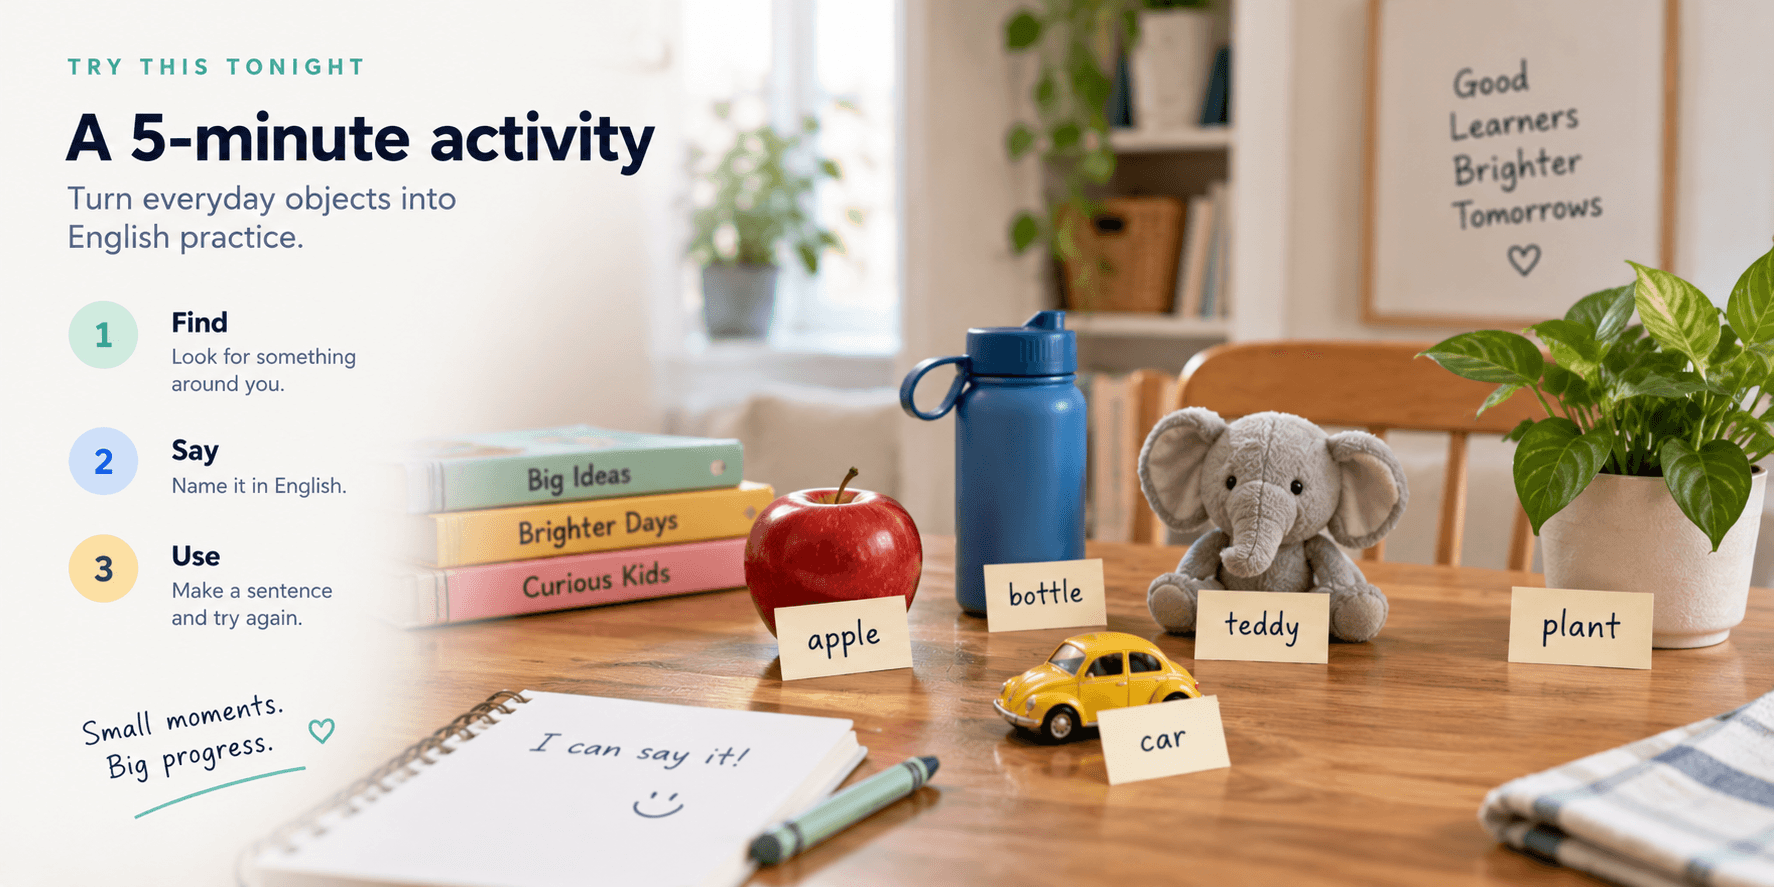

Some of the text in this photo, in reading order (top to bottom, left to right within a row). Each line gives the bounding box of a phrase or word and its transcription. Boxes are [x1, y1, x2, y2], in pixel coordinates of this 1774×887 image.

[1453, 59, 1529, 99] Good
[1450, 108, 1578, 141] Learners
[1454, 149, 1581, 193] Brighter
[1452, 197, 1602, 230] Tomorrows
[528, 464, 630, 497] Big Ideas
[519, 511, 677, 548] Brighter Days
[523, 562, 670, 598] Curious Kids
[1010, 578, 1082, 606] bottle
[809, 619, 880, 659] apple
[1225, 610, 1298, 647] teddy
[1543, 608, 1620, 647] plant
[530, 733, 750, 769] I can say it!
[1141, 731, 1185, 752] car
